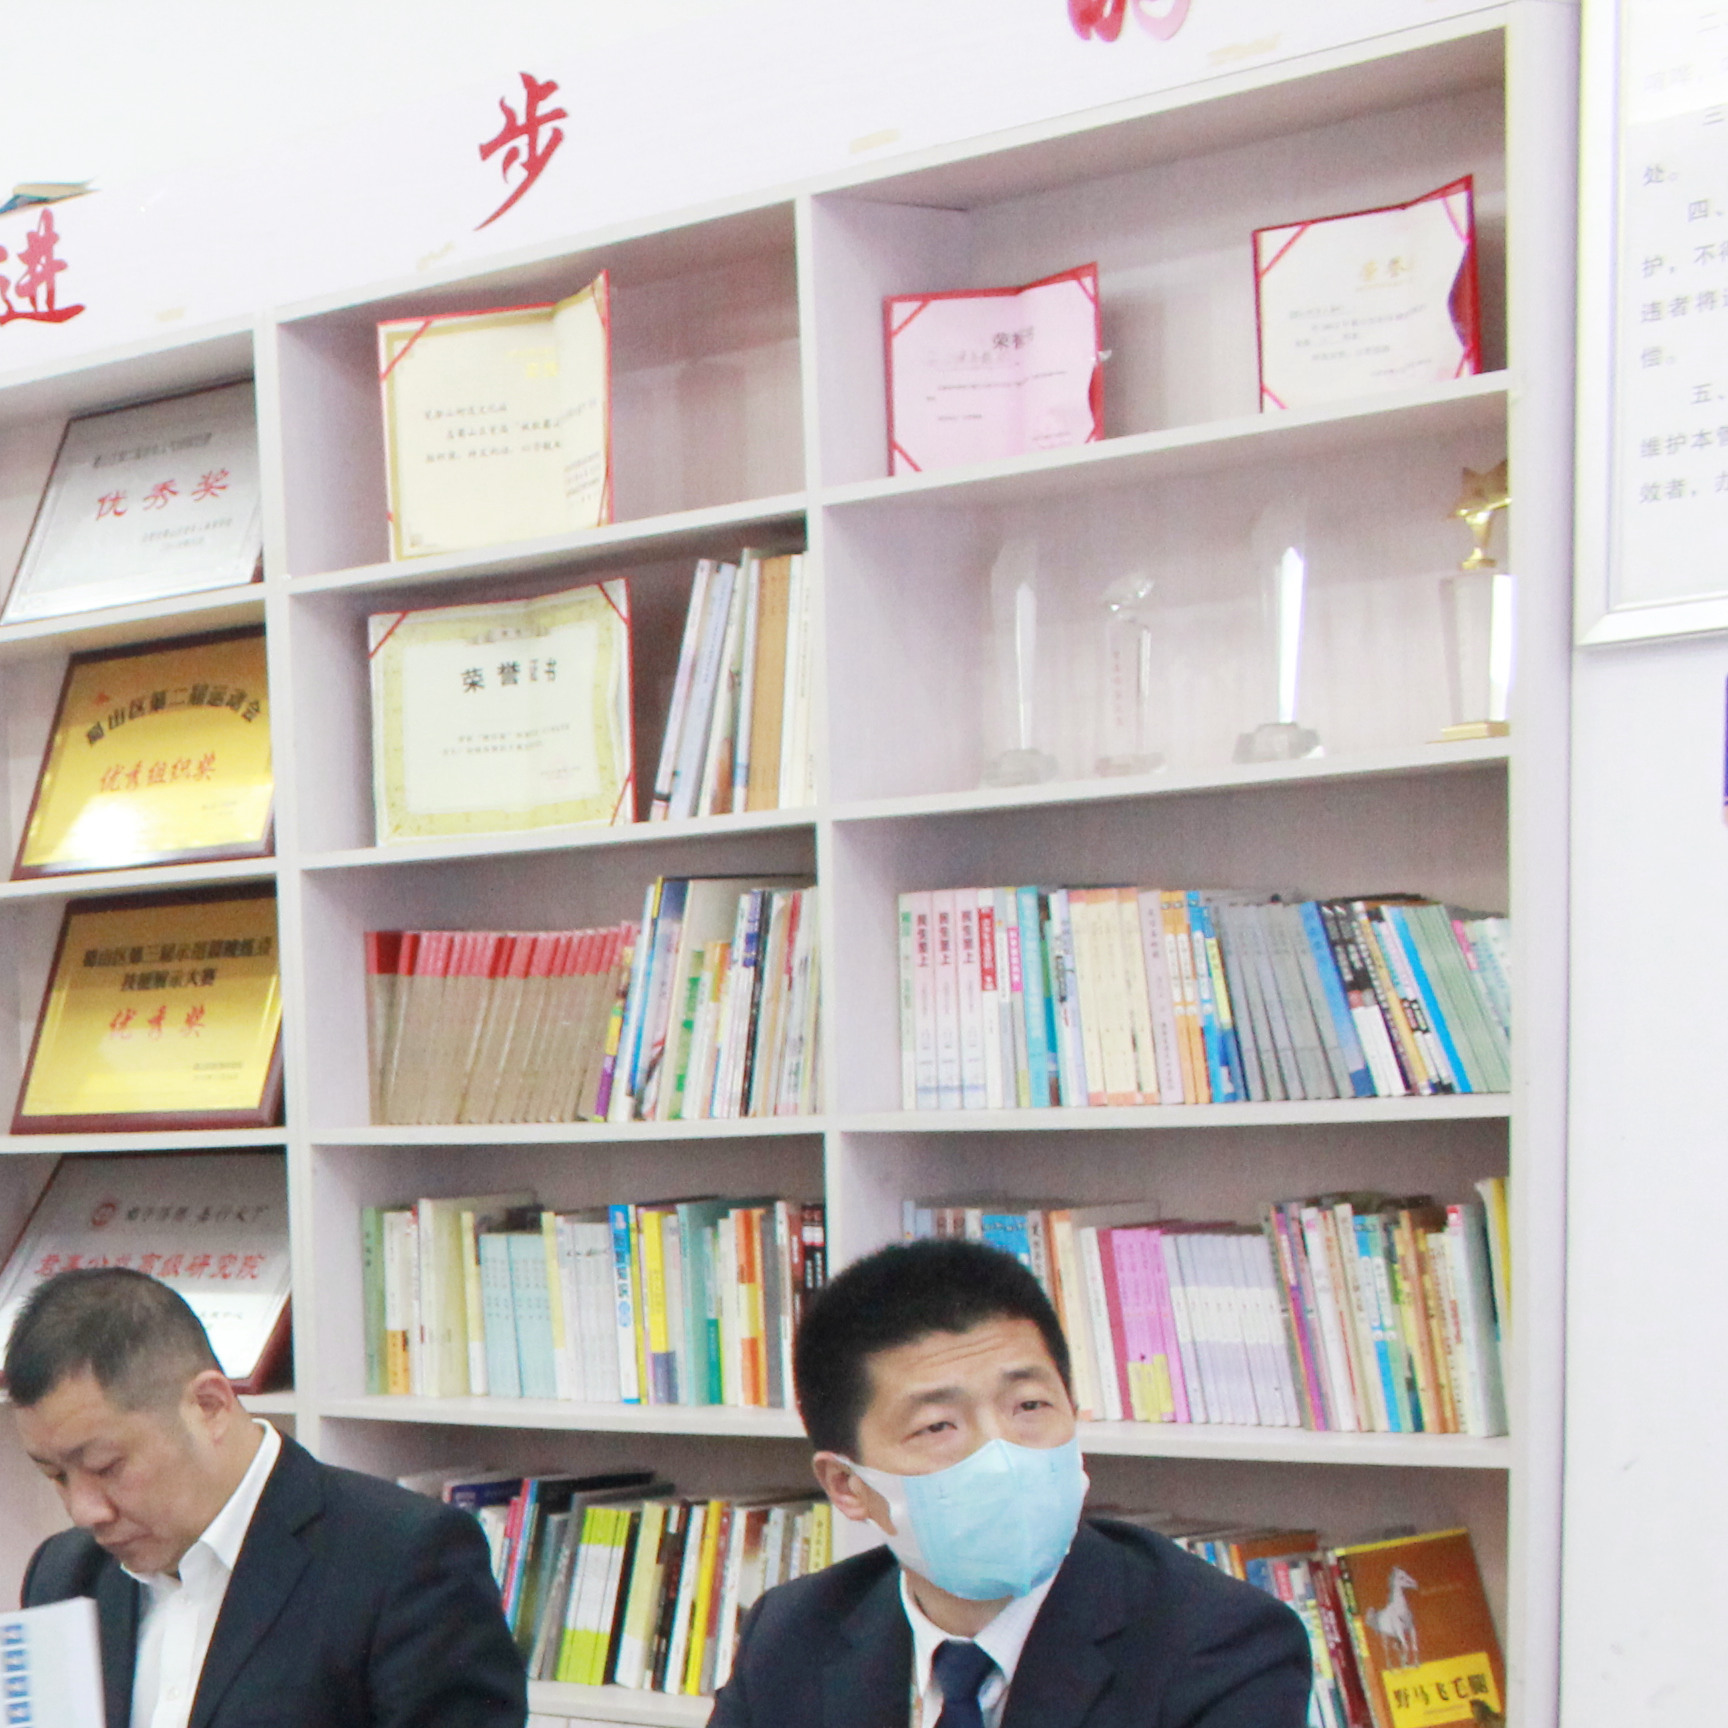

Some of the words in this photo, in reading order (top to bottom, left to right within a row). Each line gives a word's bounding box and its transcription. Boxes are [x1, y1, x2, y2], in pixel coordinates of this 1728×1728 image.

[1641, 288, 1728, 323] 违者将
[95, 466, 230, 522] 优秀奖
[461, 656, 557, 693] 荣誉证书
[86, 683, 261, 748] 蜀山区第二届运动会
[100, 752, 218, 793] 优秀组织奖
[109, 1004, 206, 1040] 优秀奖
[1393, 1673, 1489, 1709] 野马飞毛腿
